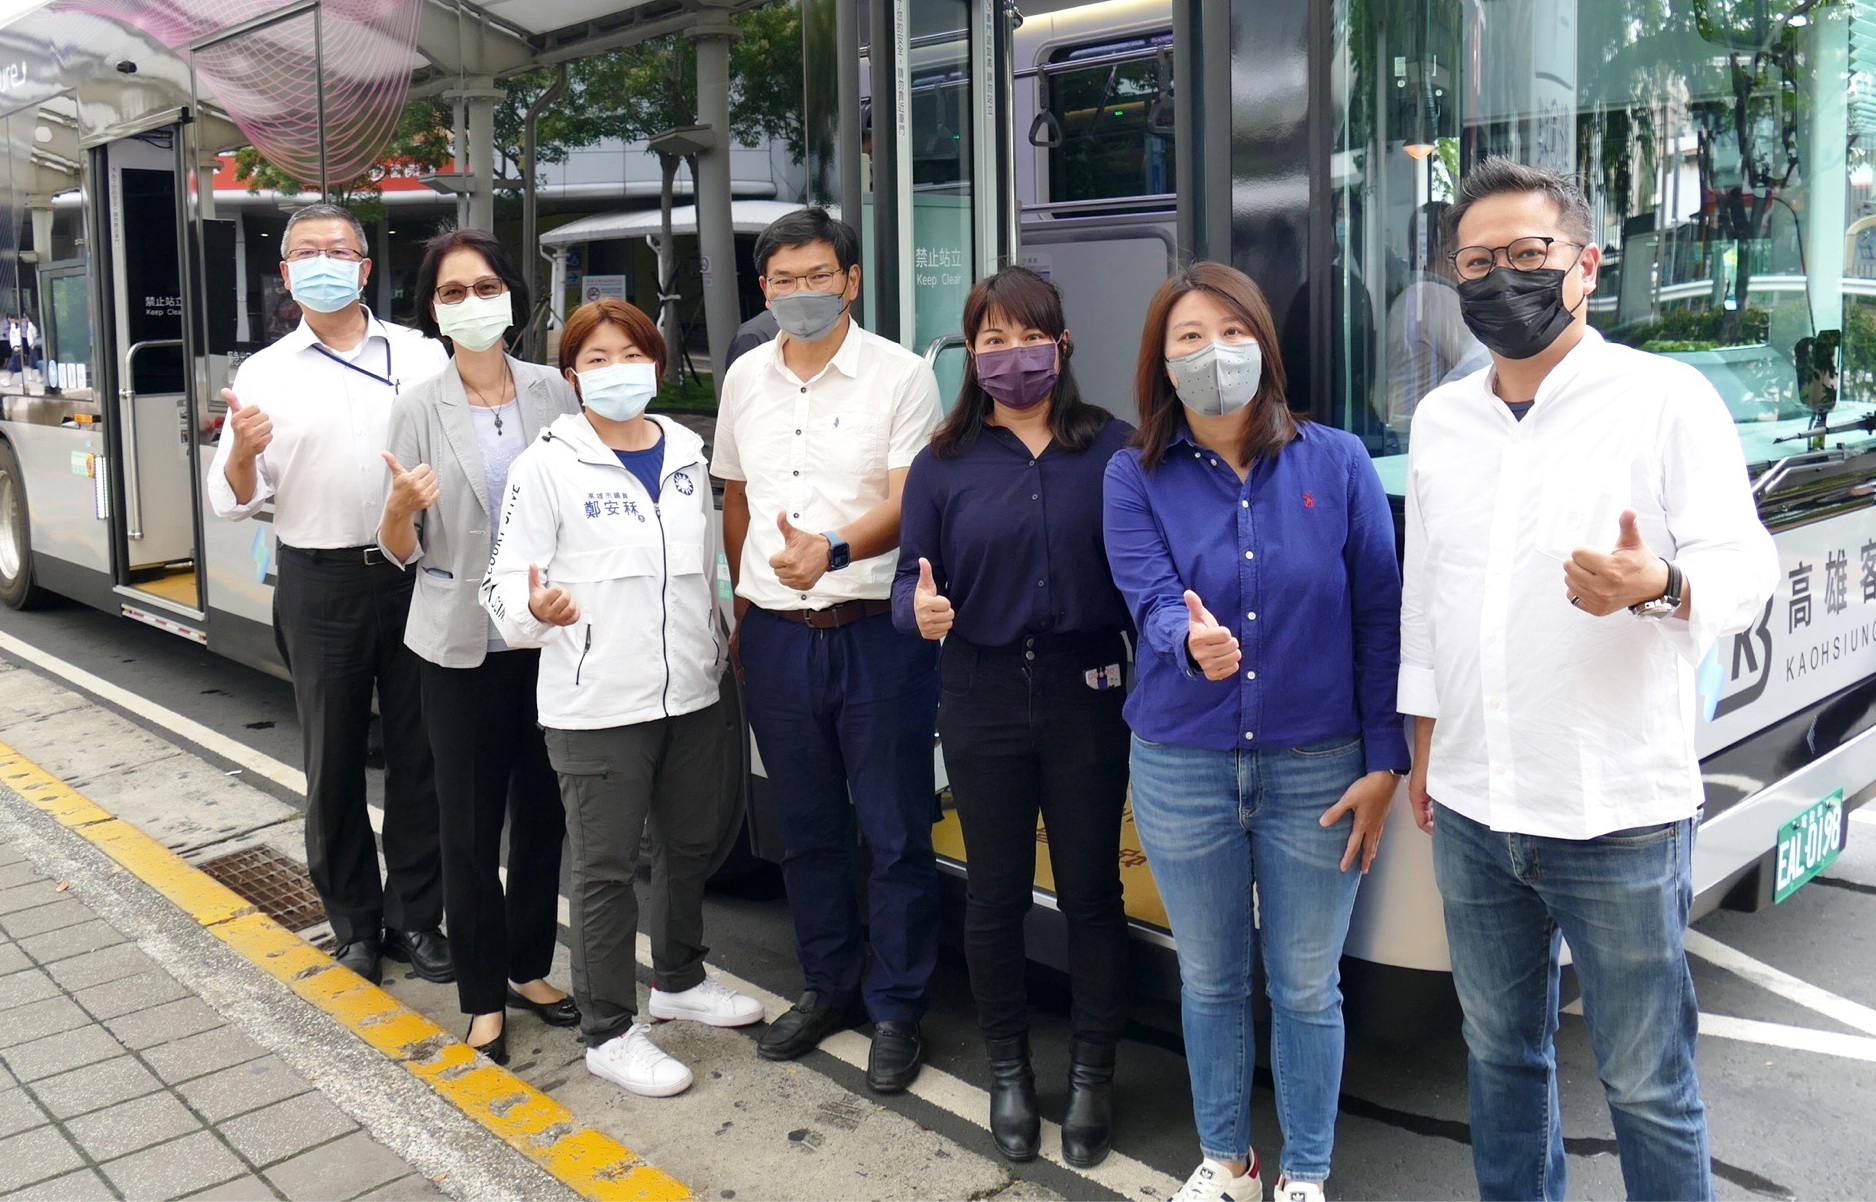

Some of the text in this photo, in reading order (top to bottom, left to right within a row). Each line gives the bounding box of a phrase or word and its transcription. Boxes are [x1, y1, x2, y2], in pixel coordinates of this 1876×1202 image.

[916, 247, 962, 268] 禁止站立
[916, 273, 961, 289] Keep Clear
[146, 308, 182, 317] Keep Clea
[1777, 804, 1842, 891] EAL-0198
